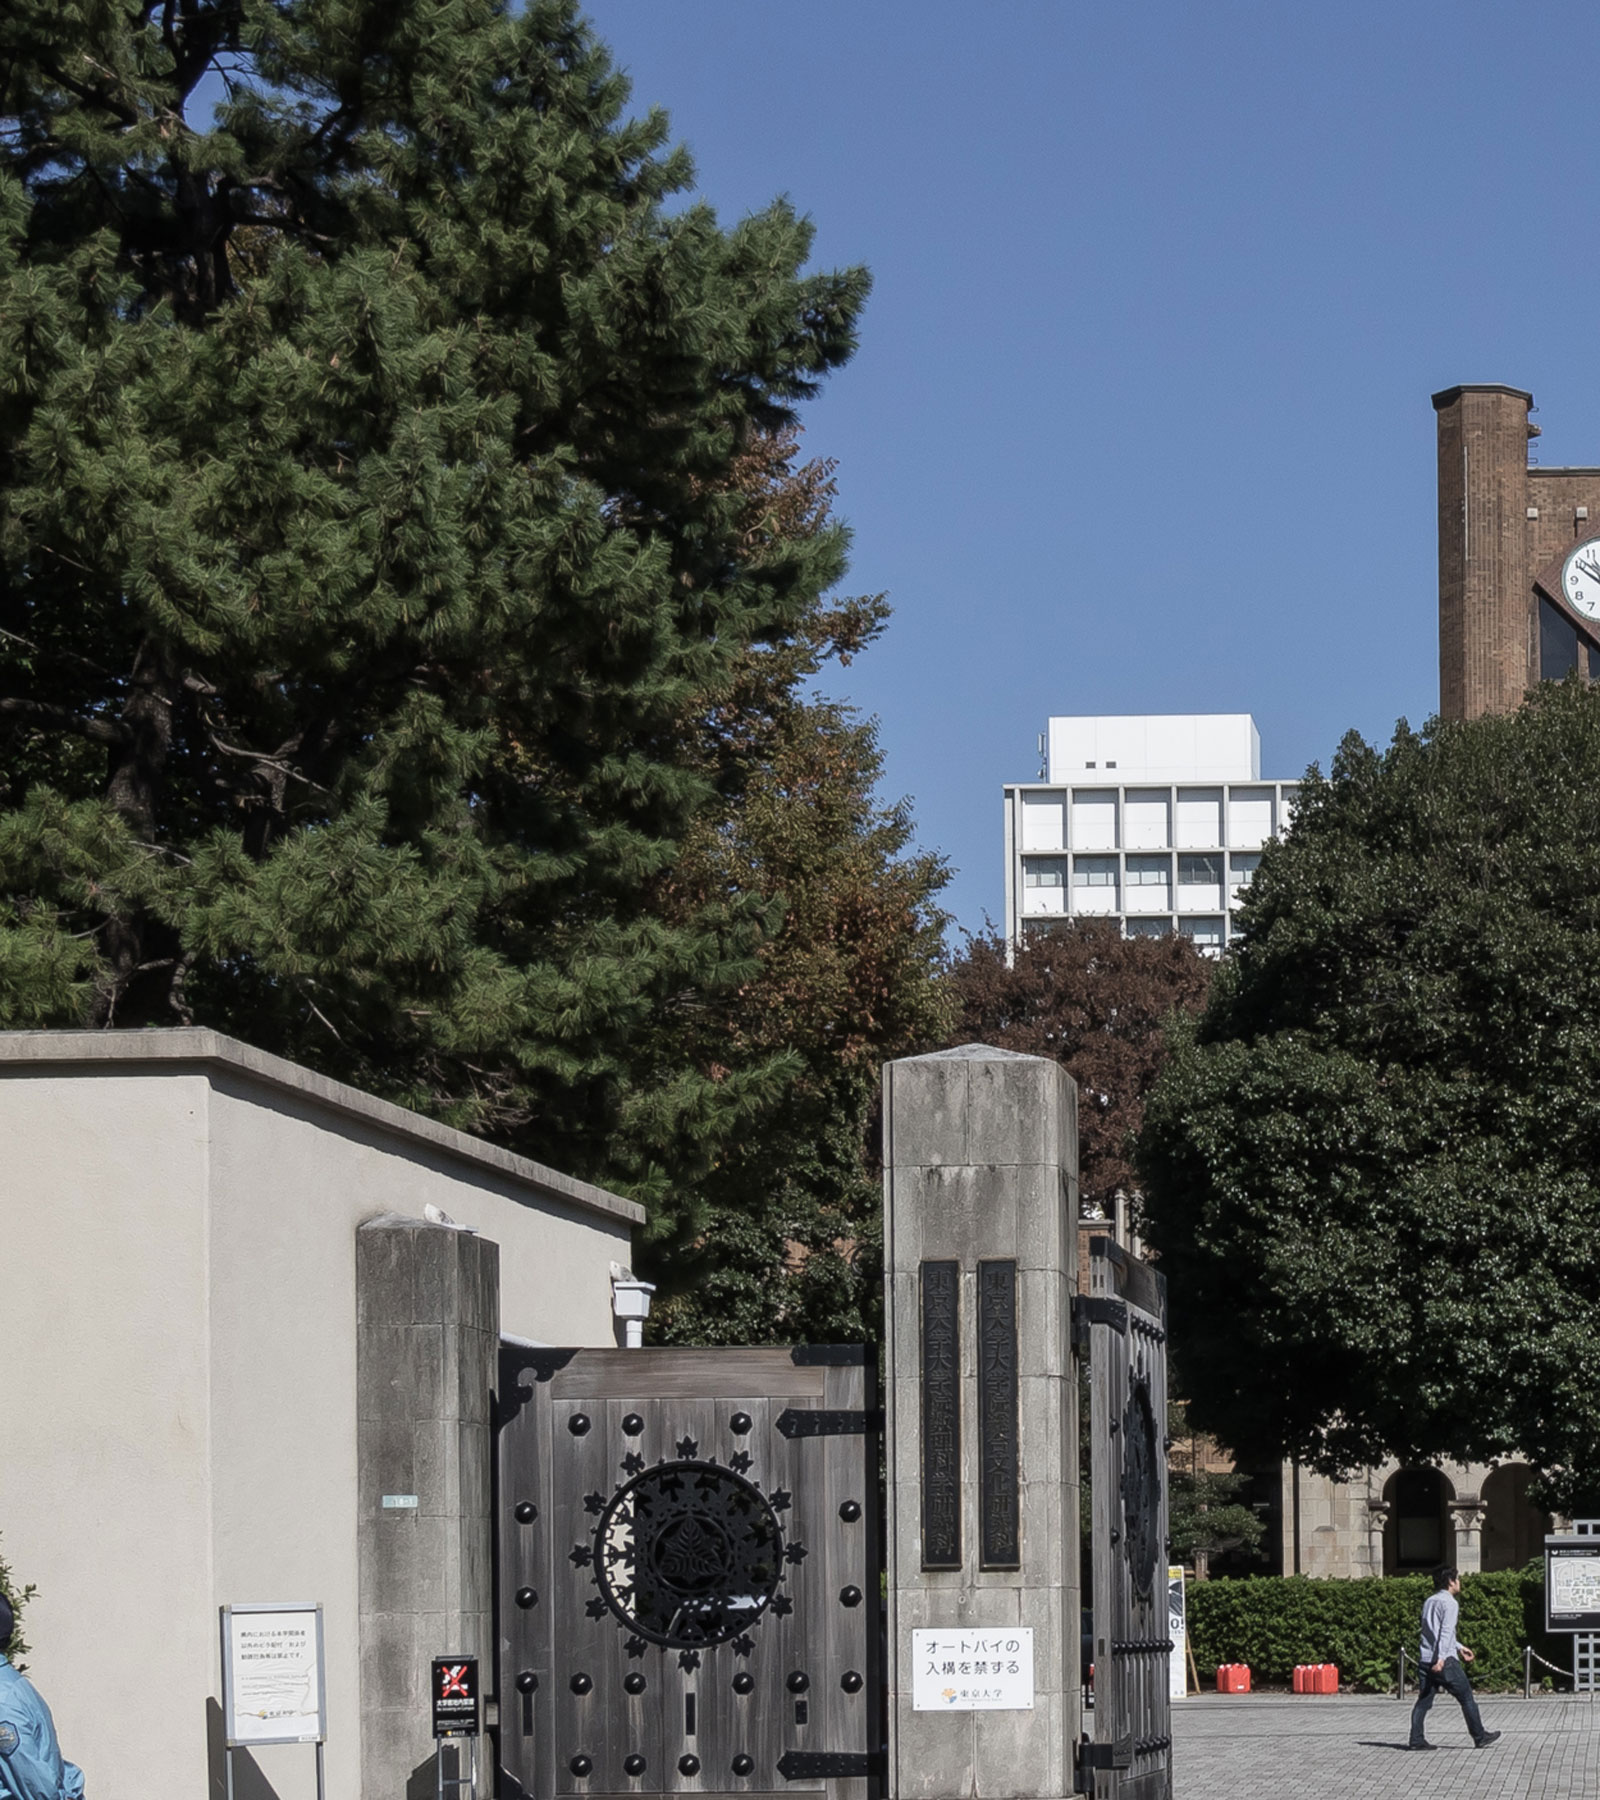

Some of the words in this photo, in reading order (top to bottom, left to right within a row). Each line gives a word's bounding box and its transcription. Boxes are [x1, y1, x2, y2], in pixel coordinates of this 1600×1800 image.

[1586, 549, 1596, 559] 11
[1570, 575, 1579, 585] 9
[1575, 591, 1584, 600] 8
[1587, 601, 1595, 612] 7
[927, 1271, 953, 1555] 東京大学大学院数理科学研究科
[986, 1271, 1012, 1555] 東京大学大学院総合文化研究科
[926, 1640, 1020, 1654] オートバイの
[926, 1661, 1020, 1675] 入構を禁ずる
[960, 1689, 1002, 1698] 東京大学
